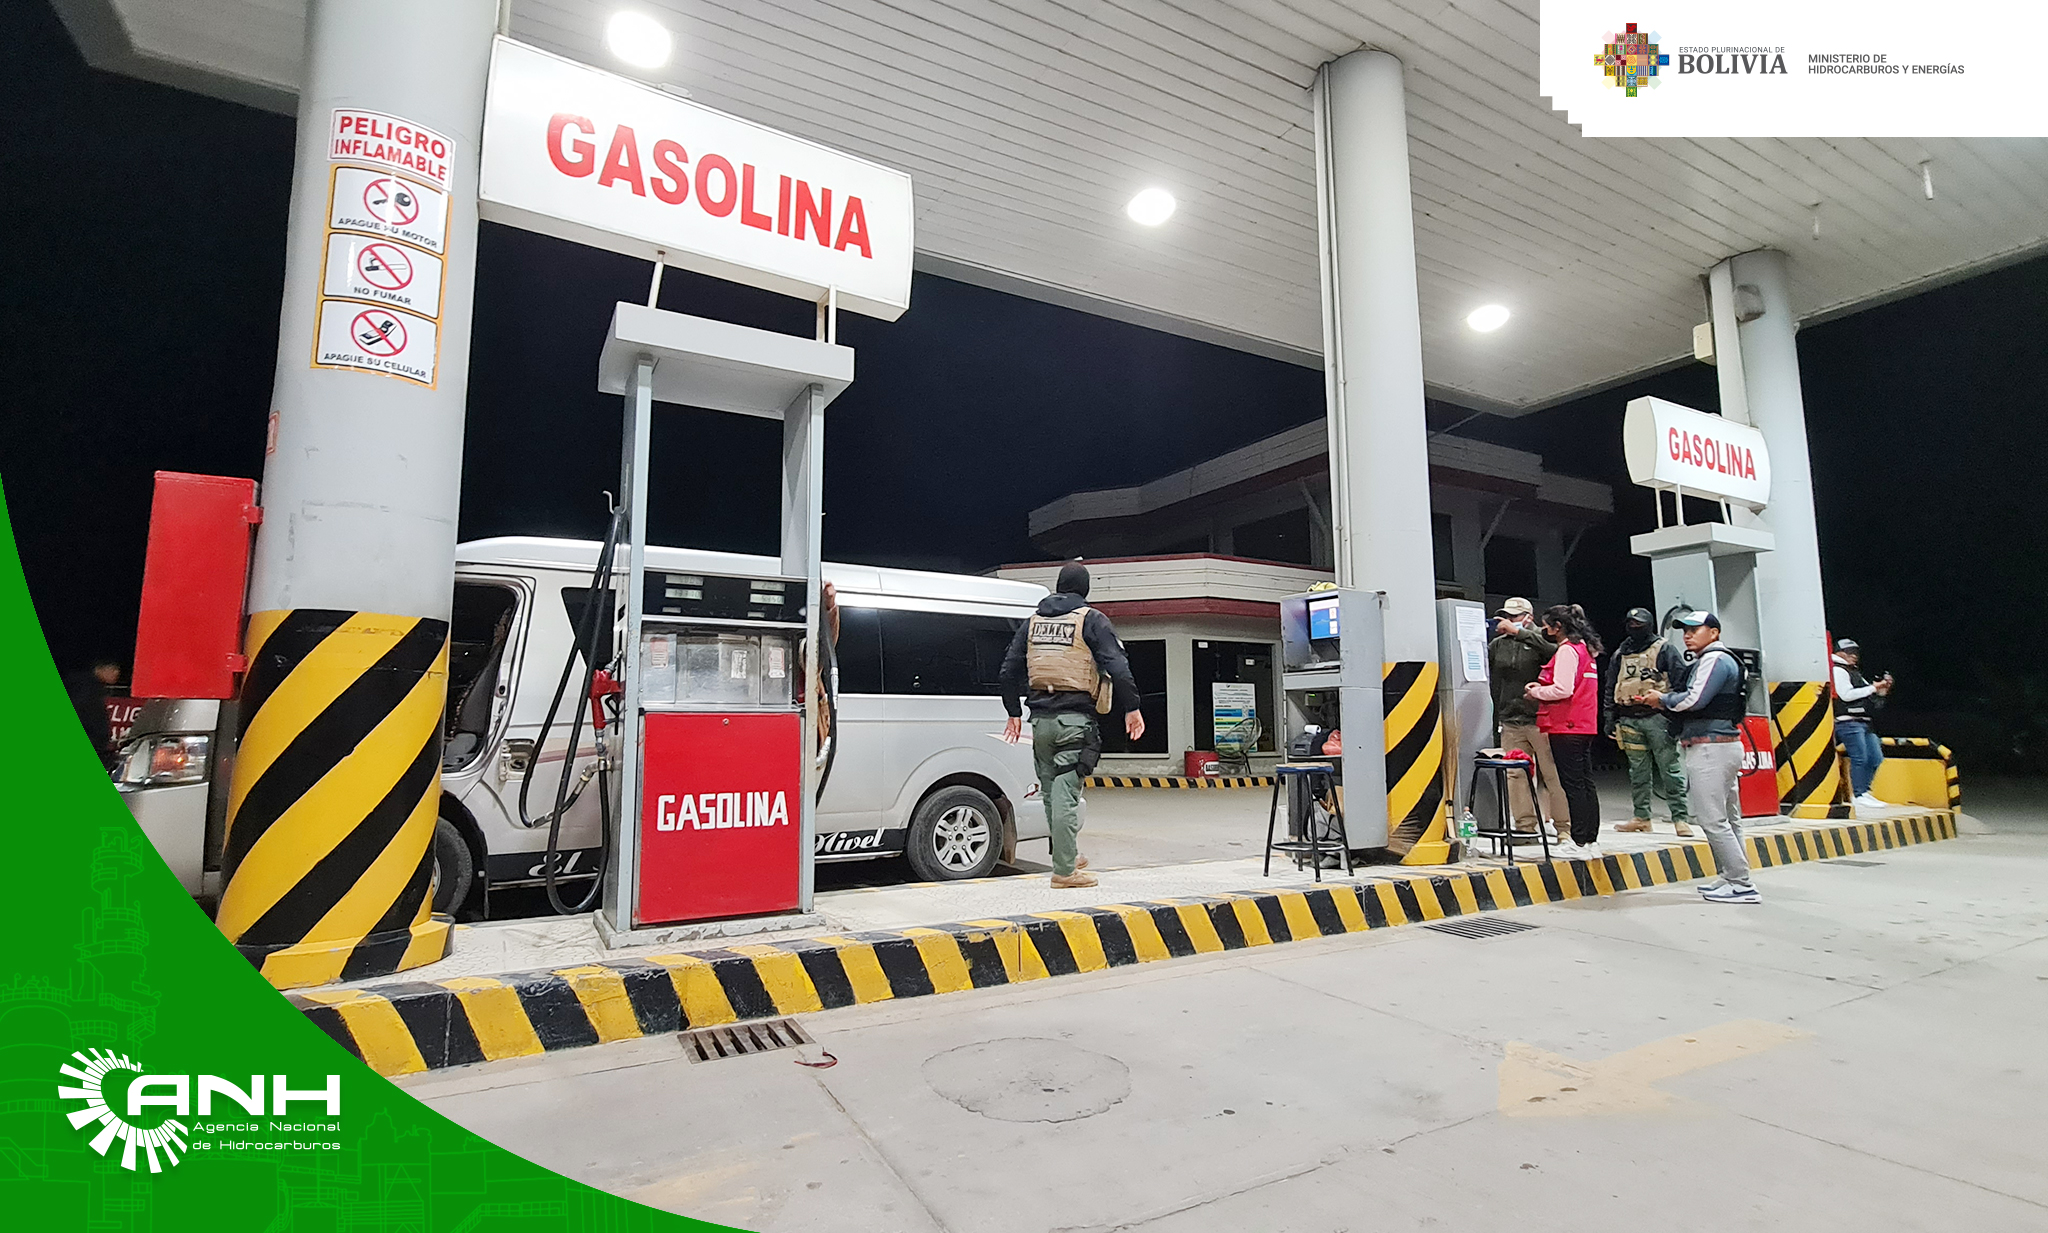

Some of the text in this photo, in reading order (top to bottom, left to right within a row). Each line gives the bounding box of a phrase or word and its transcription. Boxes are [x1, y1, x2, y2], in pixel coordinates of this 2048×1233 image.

[340, 115, 445, 159] PELIGRO
[334, 139, 447, 181] INFLAMABLE
[546, 112, 873, 259] GASOLINA
[338, 217, 381, 230] APAGUE
[402, 229, 438, 249] MOTOR
[353, 286, 412, 305] NO FUMAR
[323, 352, 428, 378] APAGUE SU CELULAR
[1668, 426, 1757, 481] GASOLINA
[1033, 623, 1066, 637] DELTA
[1741, 750, 1775, 770] ASLINA
[656, 791, 790, 832] GASOLINA
